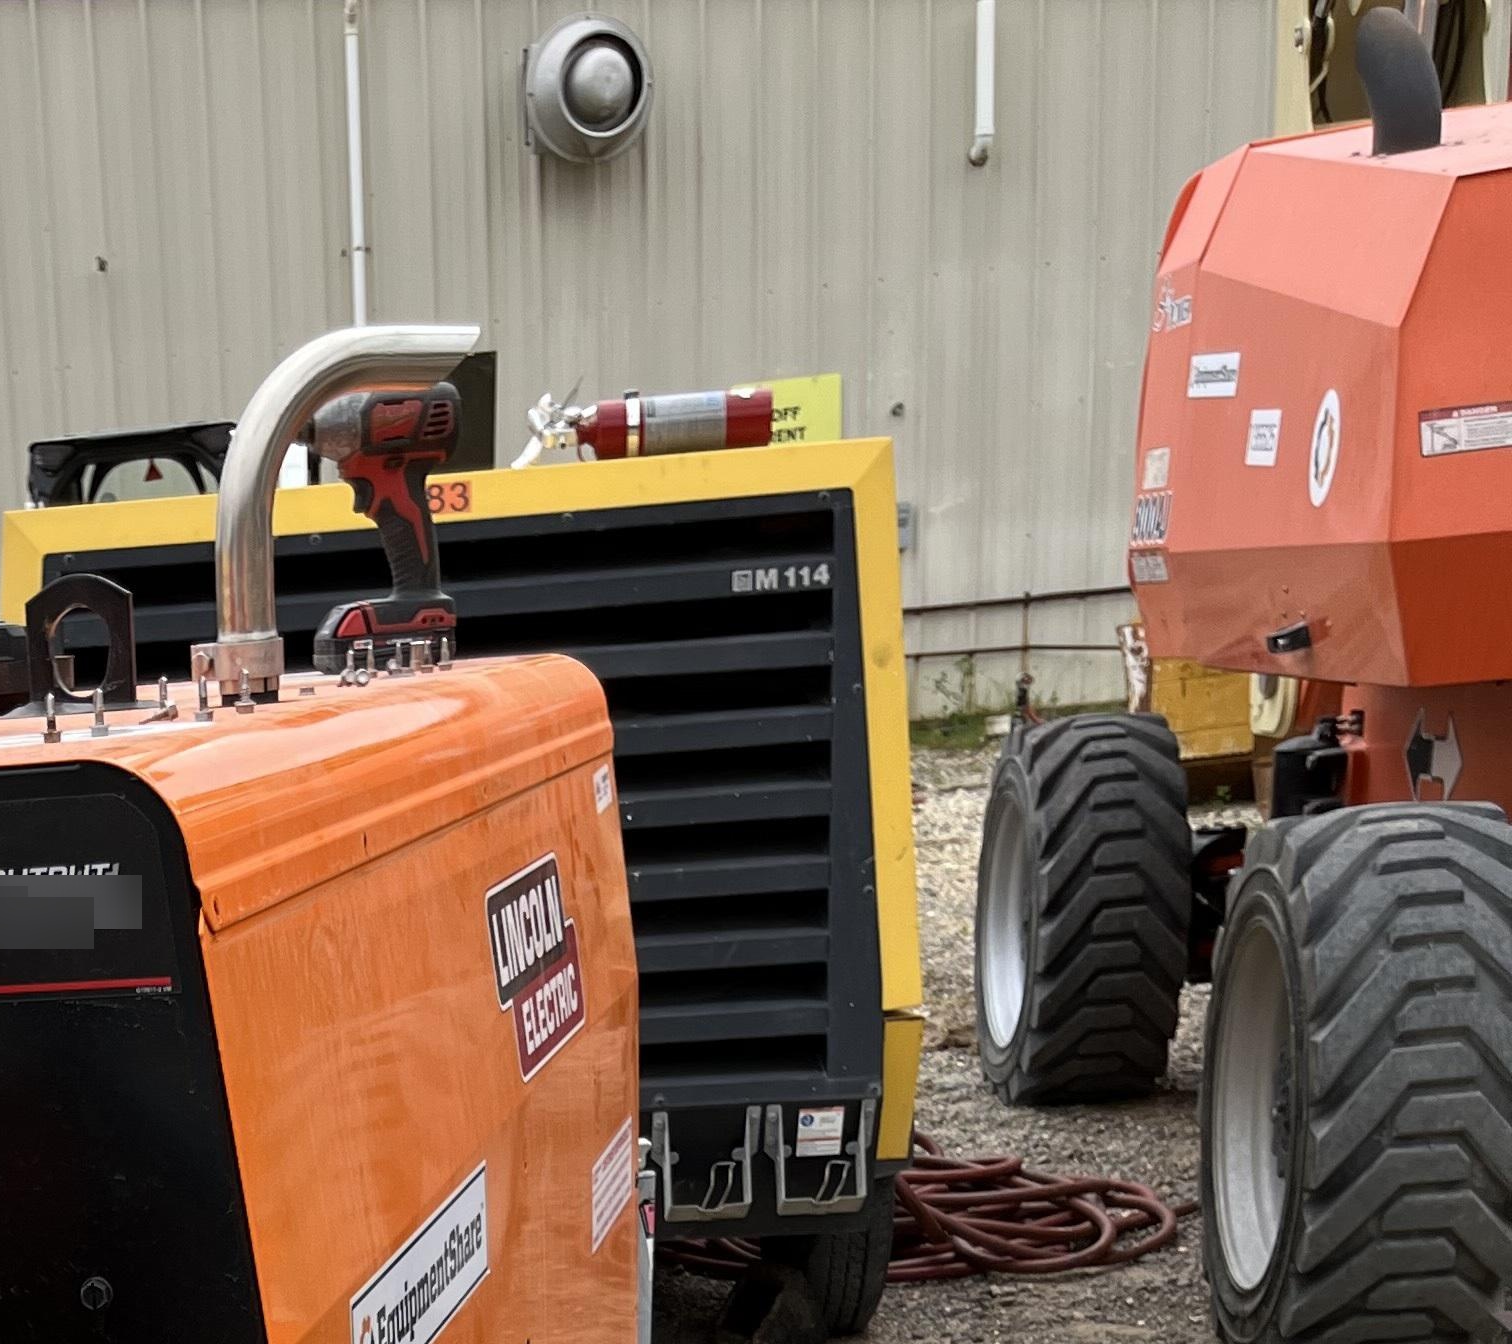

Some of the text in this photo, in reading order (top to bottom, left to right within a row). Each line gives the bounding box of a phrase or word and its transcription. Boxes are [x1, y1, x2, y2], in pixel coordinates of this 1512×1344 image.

[784, 563, 831, 589] 114
[491, 875, 564, 988] LINCOLN
[521, 963, 578, 1056] ELECTRIC
